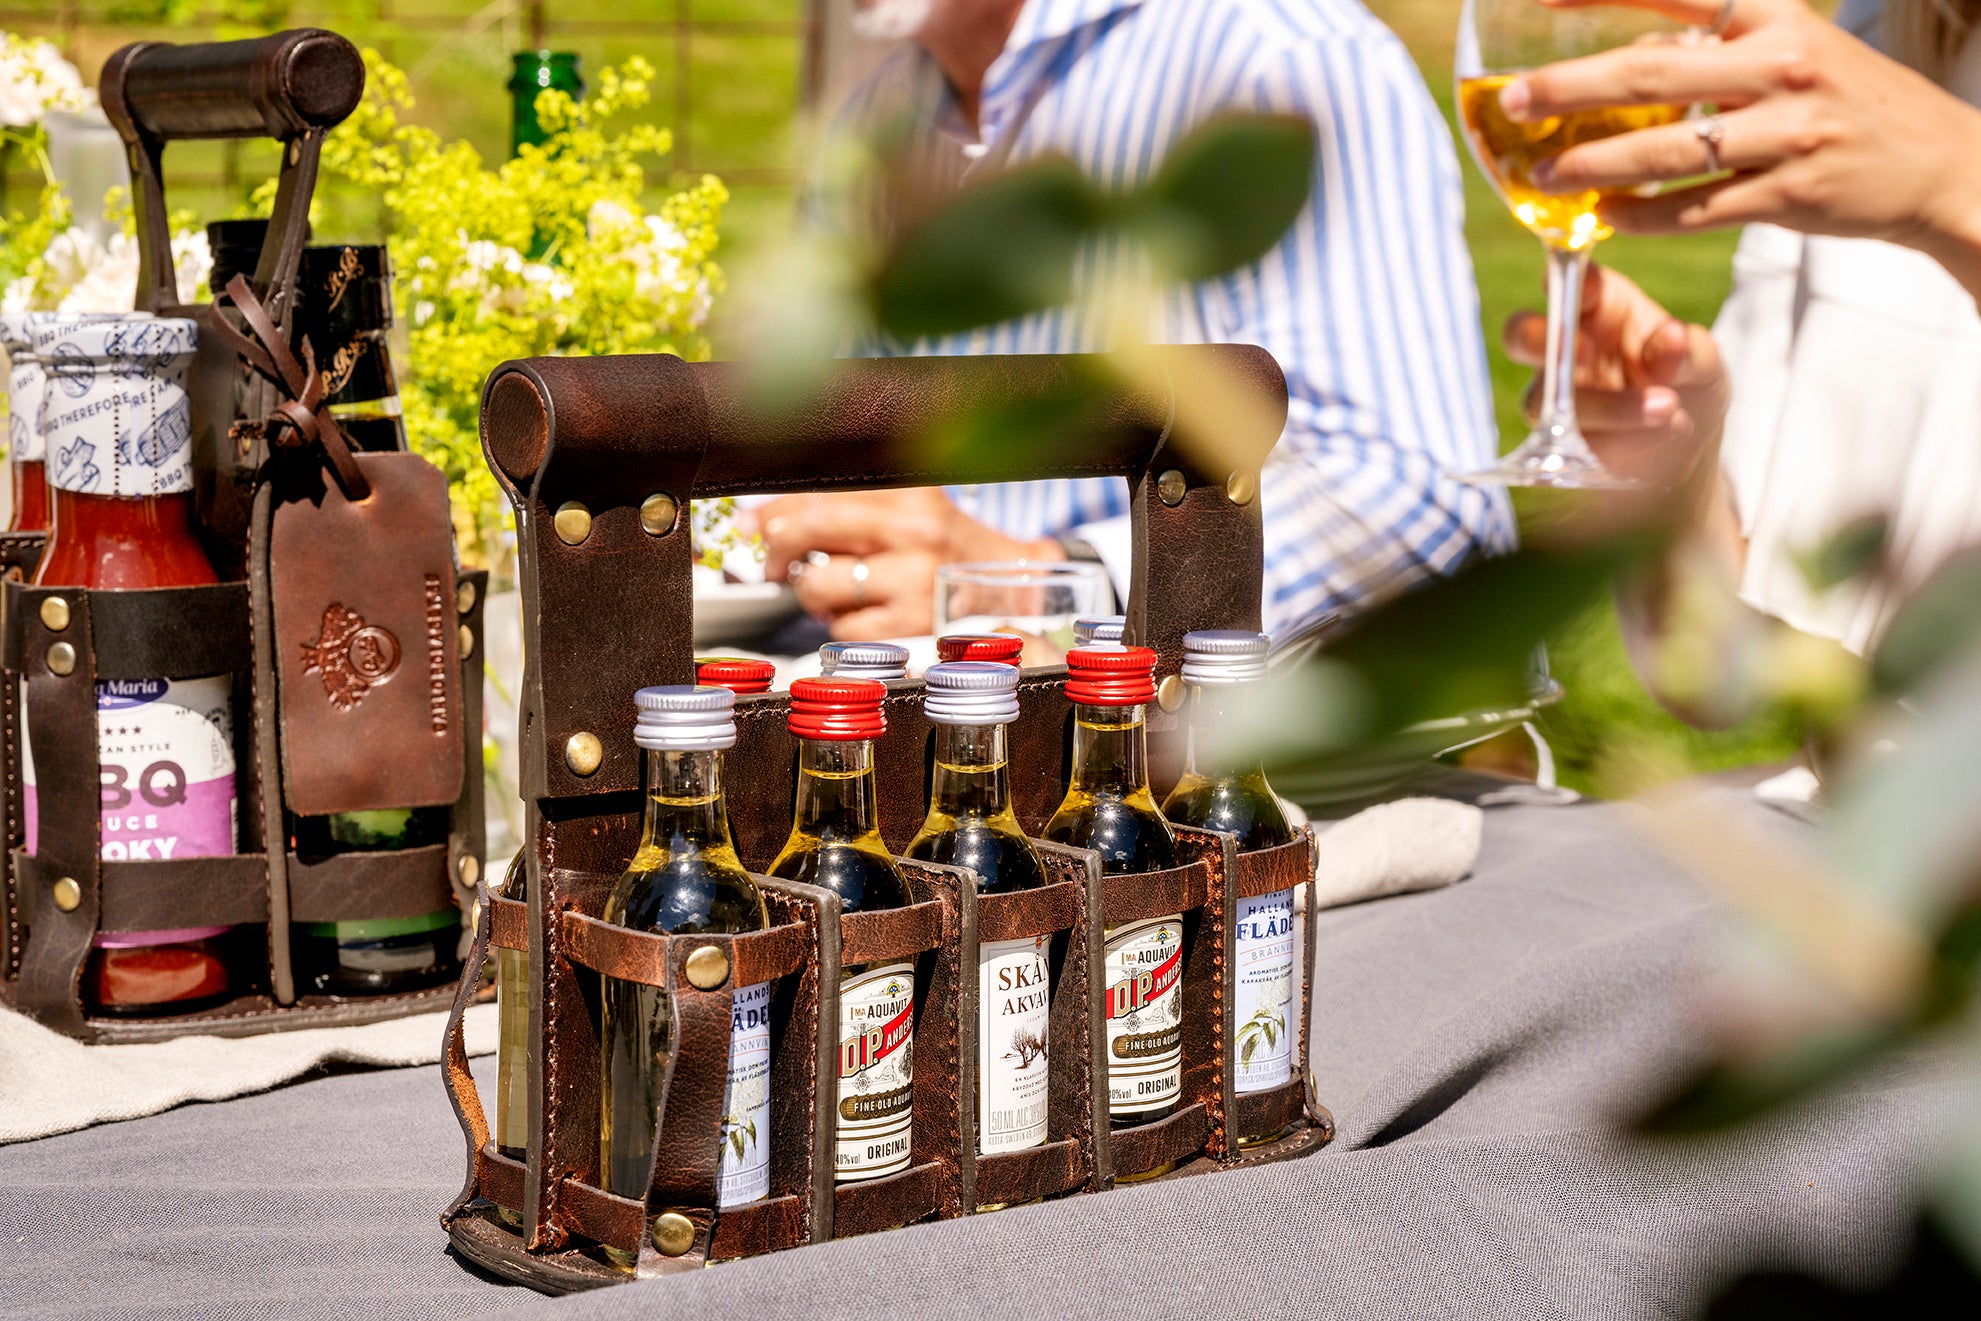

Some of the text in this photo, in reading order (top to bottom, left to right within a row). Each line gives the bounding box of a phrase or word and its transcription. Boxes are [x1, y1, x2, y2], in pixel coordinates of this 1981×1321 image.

[107, 679, 158, 696] Maria
[1138, 945, 1176, 964] AQUAVIT
[867, 998, 908, 1018] AQUAVIT
[1125, 1040, 1145, 1051] FINE
[1147, 1038, 1162, 1049] OLD
[1138, 1074, 1177, 1095] ORIGINAL
[854, 1101, 877, 1112] FINE
[878, 1098, 892, 1109] OLD
[867, 1137, 908, 1160] ORIGINAL
